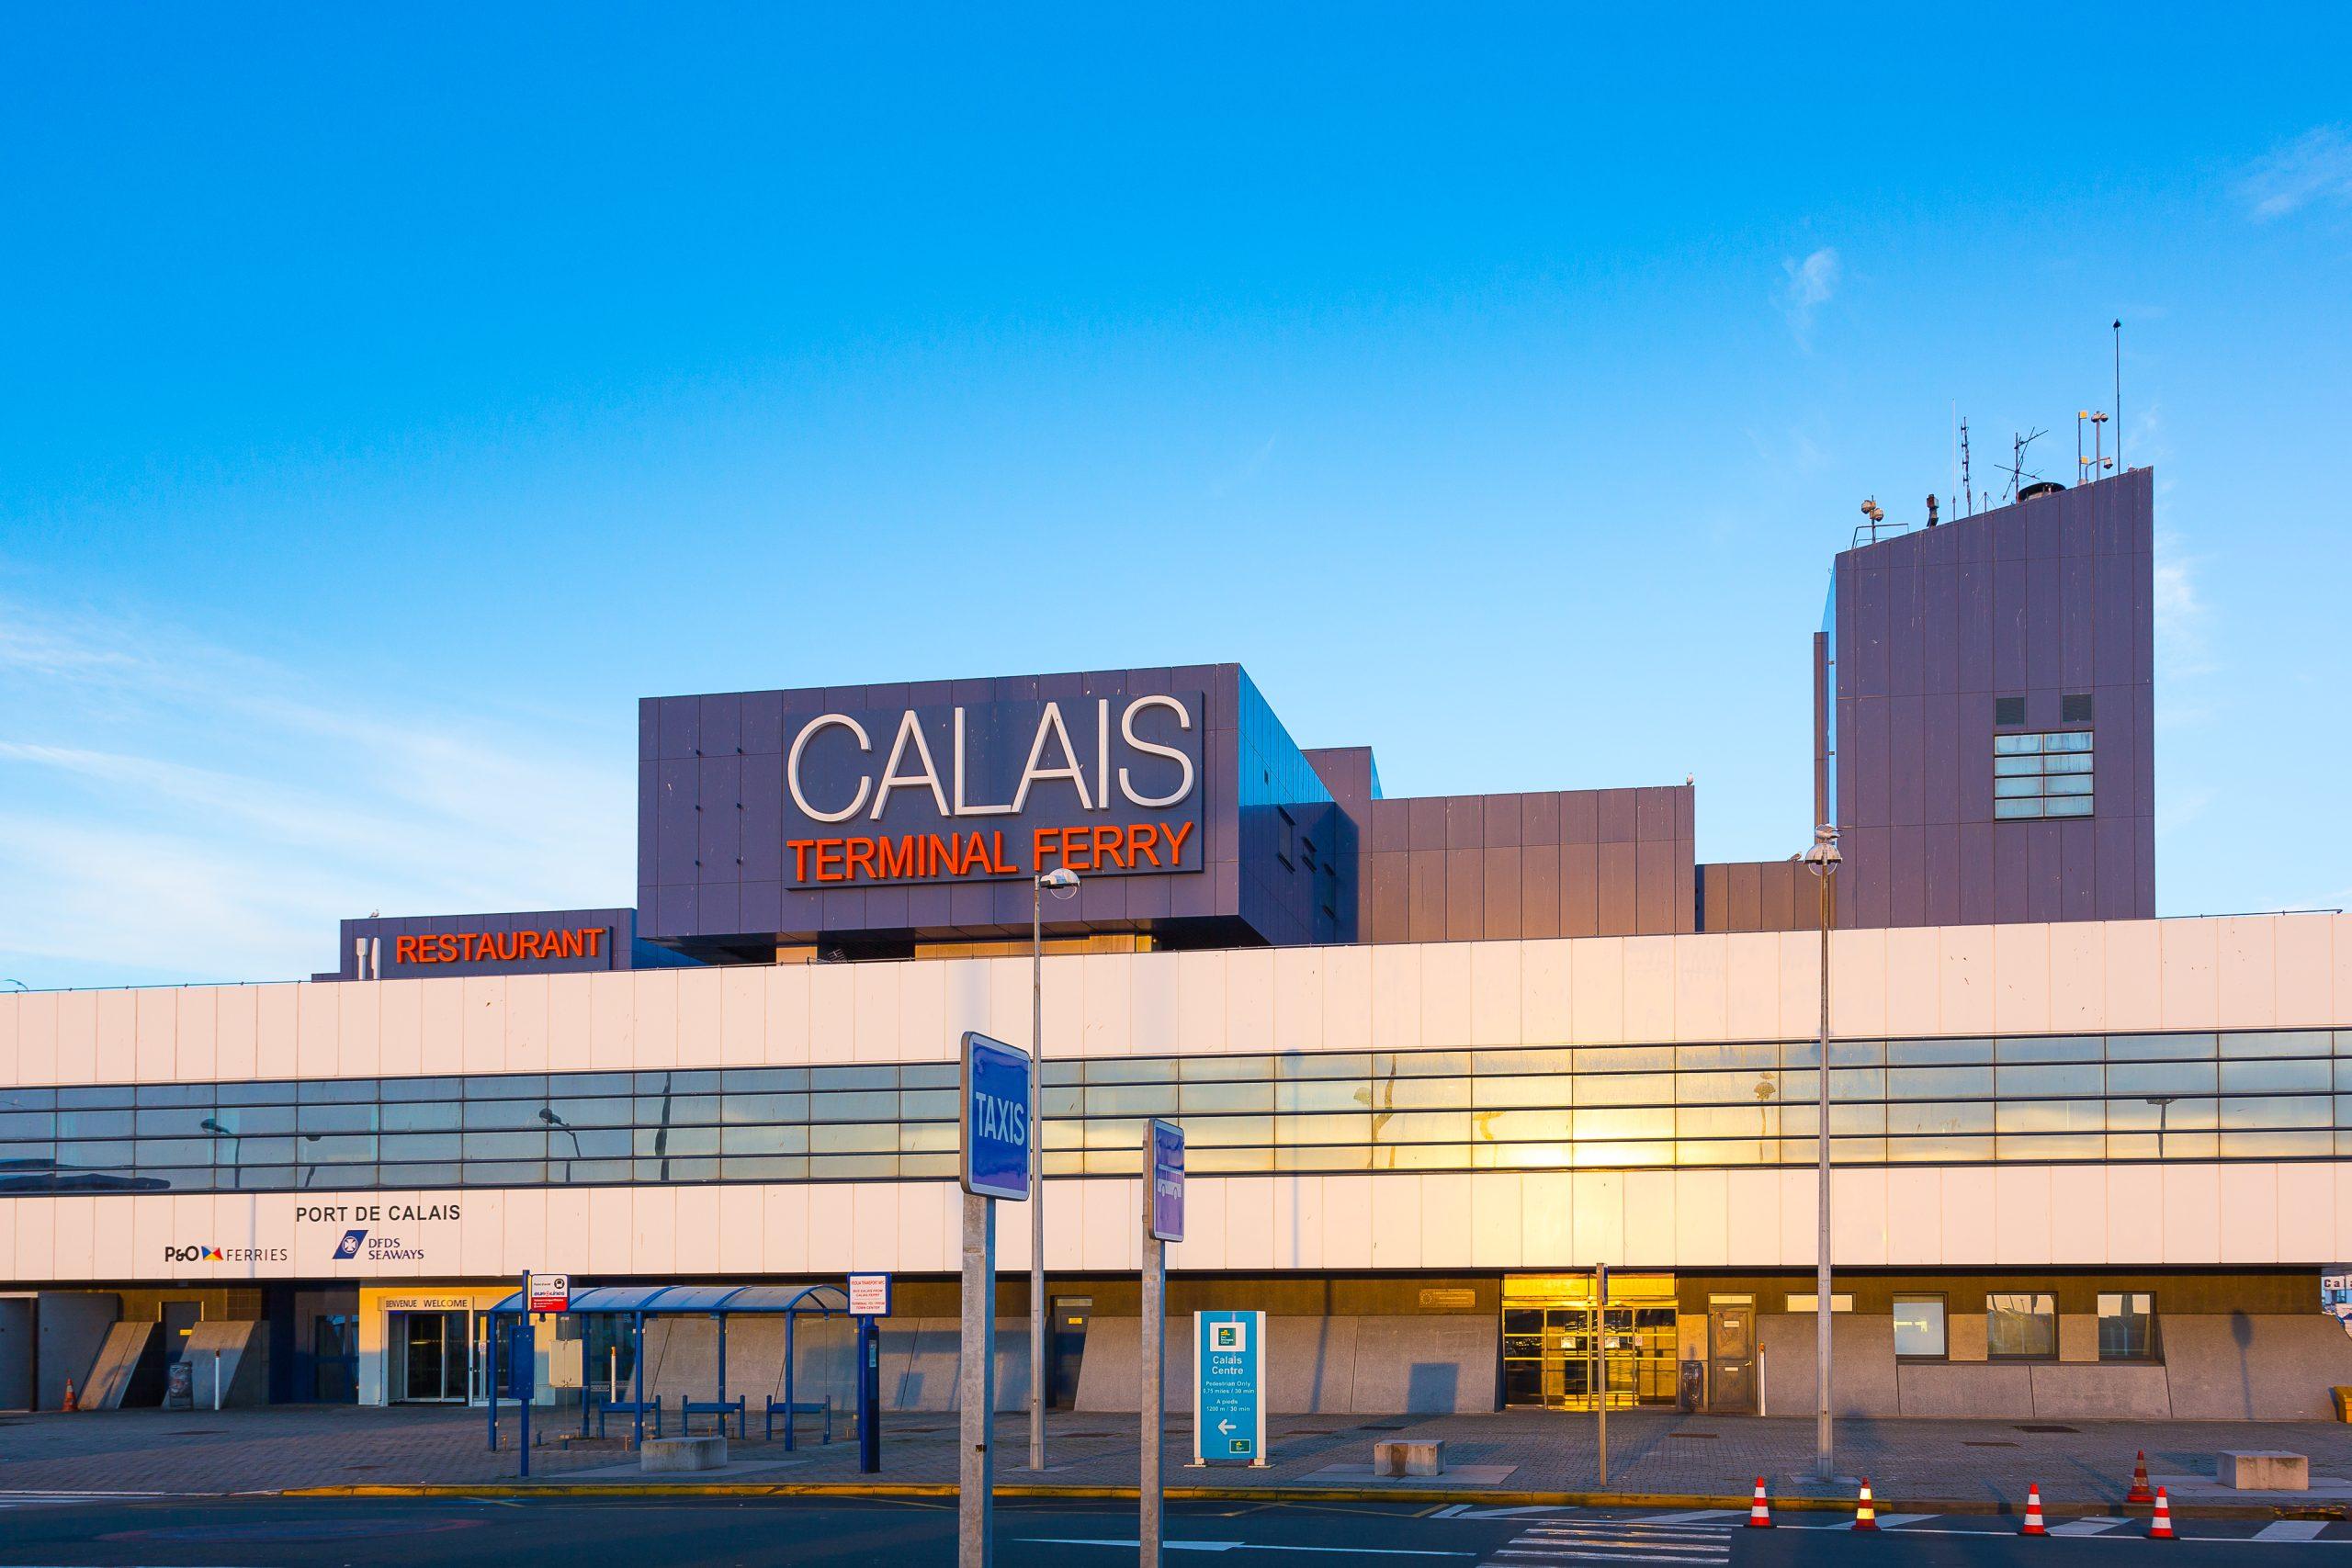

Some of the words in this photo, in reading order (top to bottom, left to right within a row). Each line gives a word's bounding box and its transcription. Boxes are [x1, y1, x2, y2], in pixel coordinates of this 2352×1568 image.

[787, 694, 1195, 822] CALAIS
[786, 829, 1019, 883] TERMINAL
[1033, 821, 1195, 872] FERRY
[396, 928, 605, 964] RESTAURANT
[975, 1091, 1025, 1146] TAXIS
[296, 1206, 348, 1223] PORT
[356, 1206, 380, 1222] DE
[388, 1204, 461, 1222] CALAIS
[368, 1237, 401, 1249] DFDS
[164, 1245, 200, 1263] P&O
[226, 1248, 288, 1262] FERRIES
[368, 1248, 424, 1261] SEAWAYS
[423, 1299, 468, 1308] WELCOME
[1213, 1356, 1242, 1364] Calais
[1212, 1366, 1244, 1375] Centre
